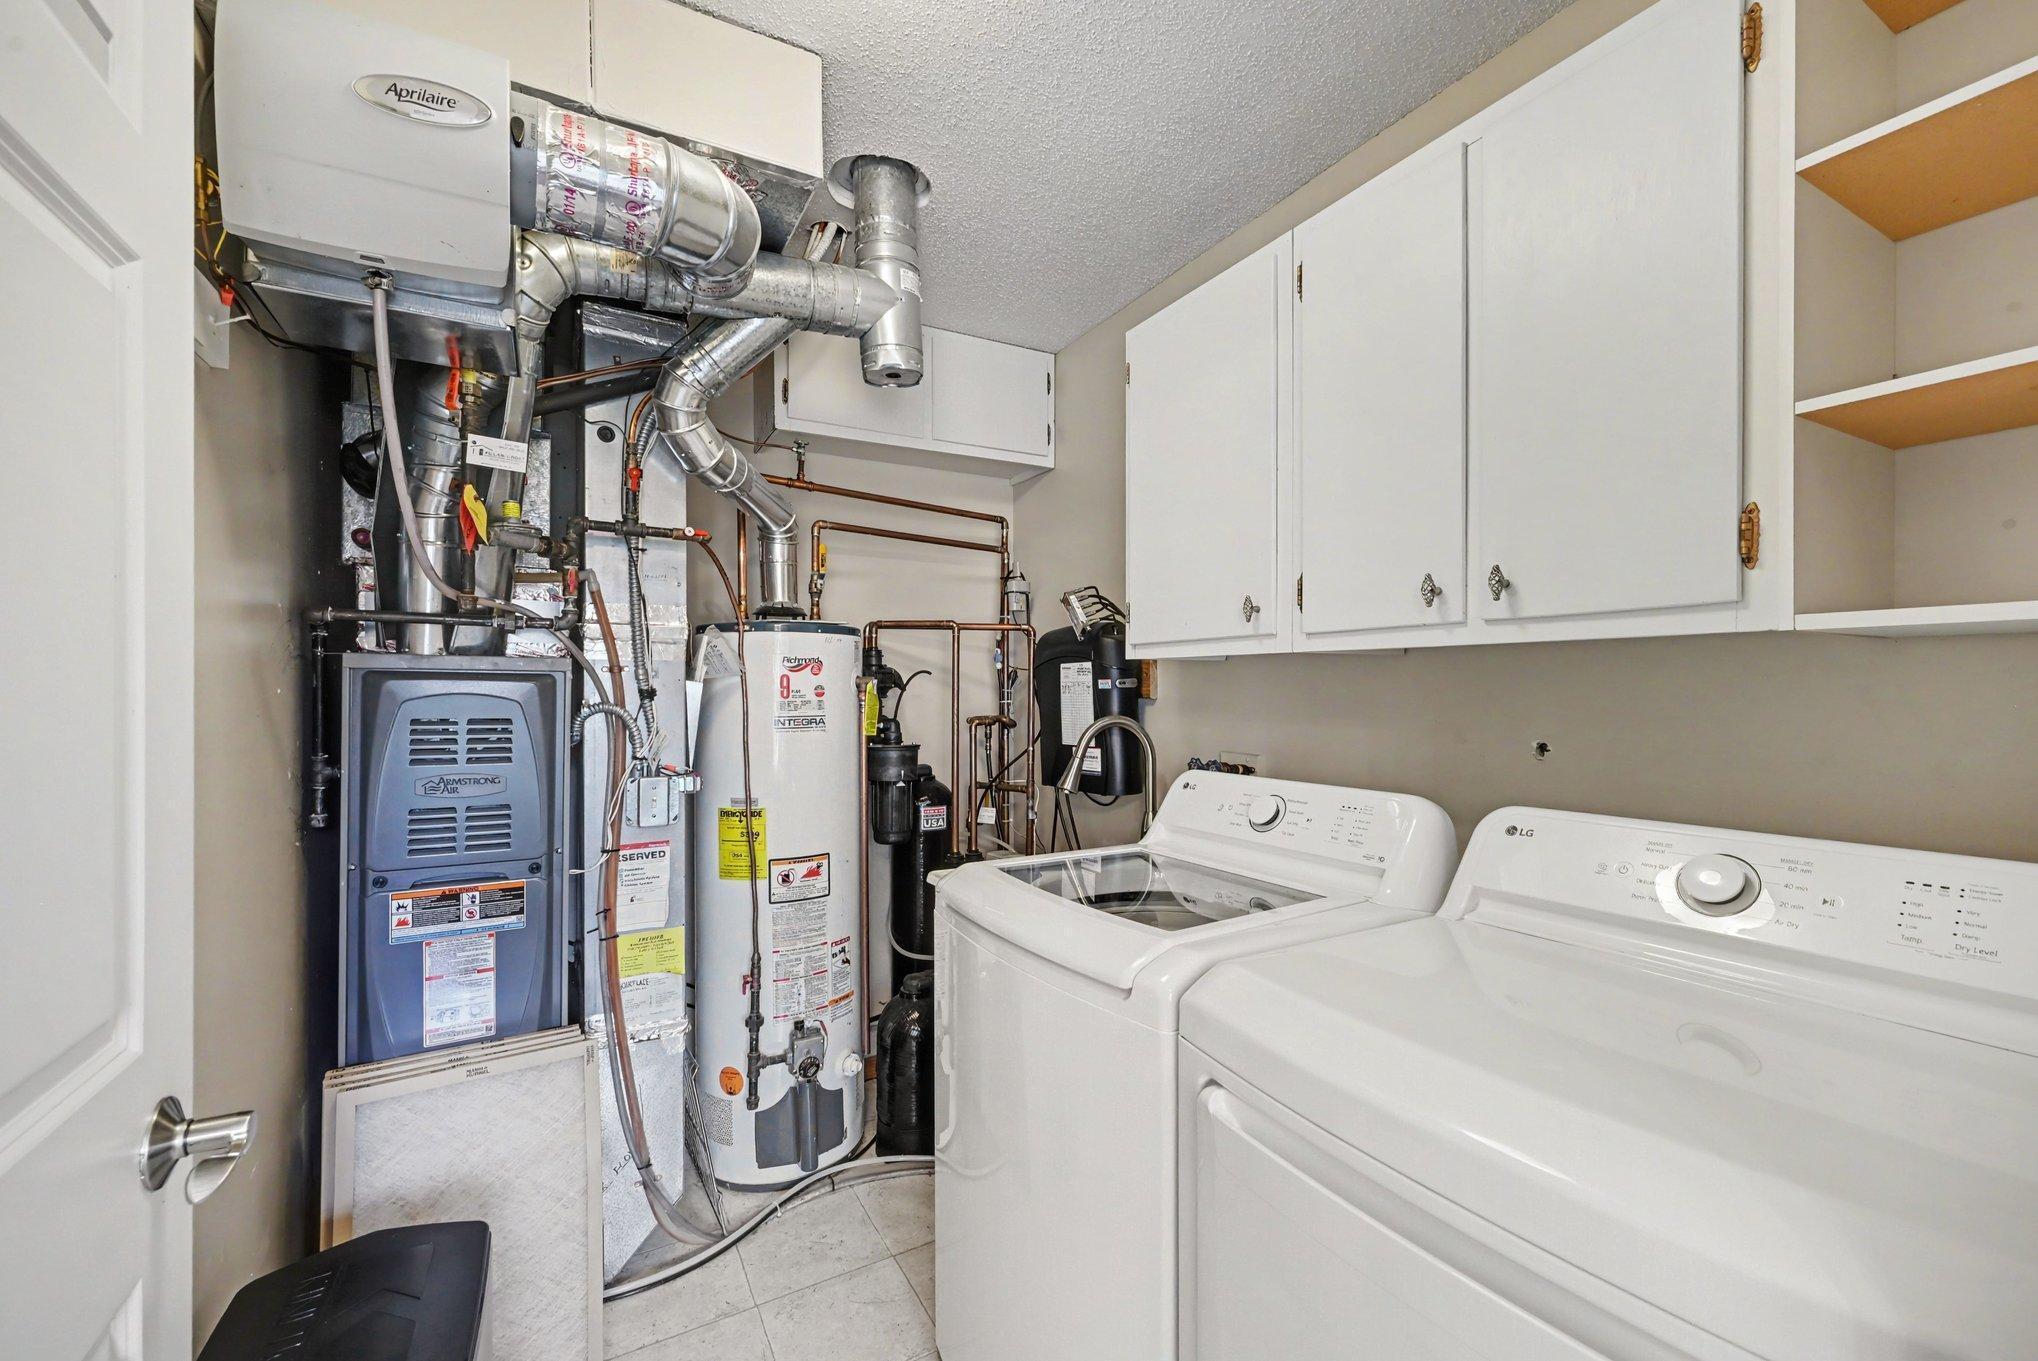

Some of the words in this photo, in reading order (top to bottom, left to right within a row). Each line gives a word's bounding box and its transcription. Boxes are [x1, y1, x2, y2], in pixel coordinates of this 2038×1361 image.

[384, 82, 457, 109] Aprilaire
[563, 187, 578, 216] 01/14
[782, 655, 821, 665] Richmond
[779, 673, 791, 700] 9
[773, 717, 827, 728] INTEGRA
[437, 776, 501, 787] ARMSTRONG
[440, 785, 460, 795] AIR
[923, 818, 944, 828] USA
[1519, 828, 1534, 837] LG
[1955, 943, 1970, 954] Dry
[1974, 947, 1998, 958] Level
